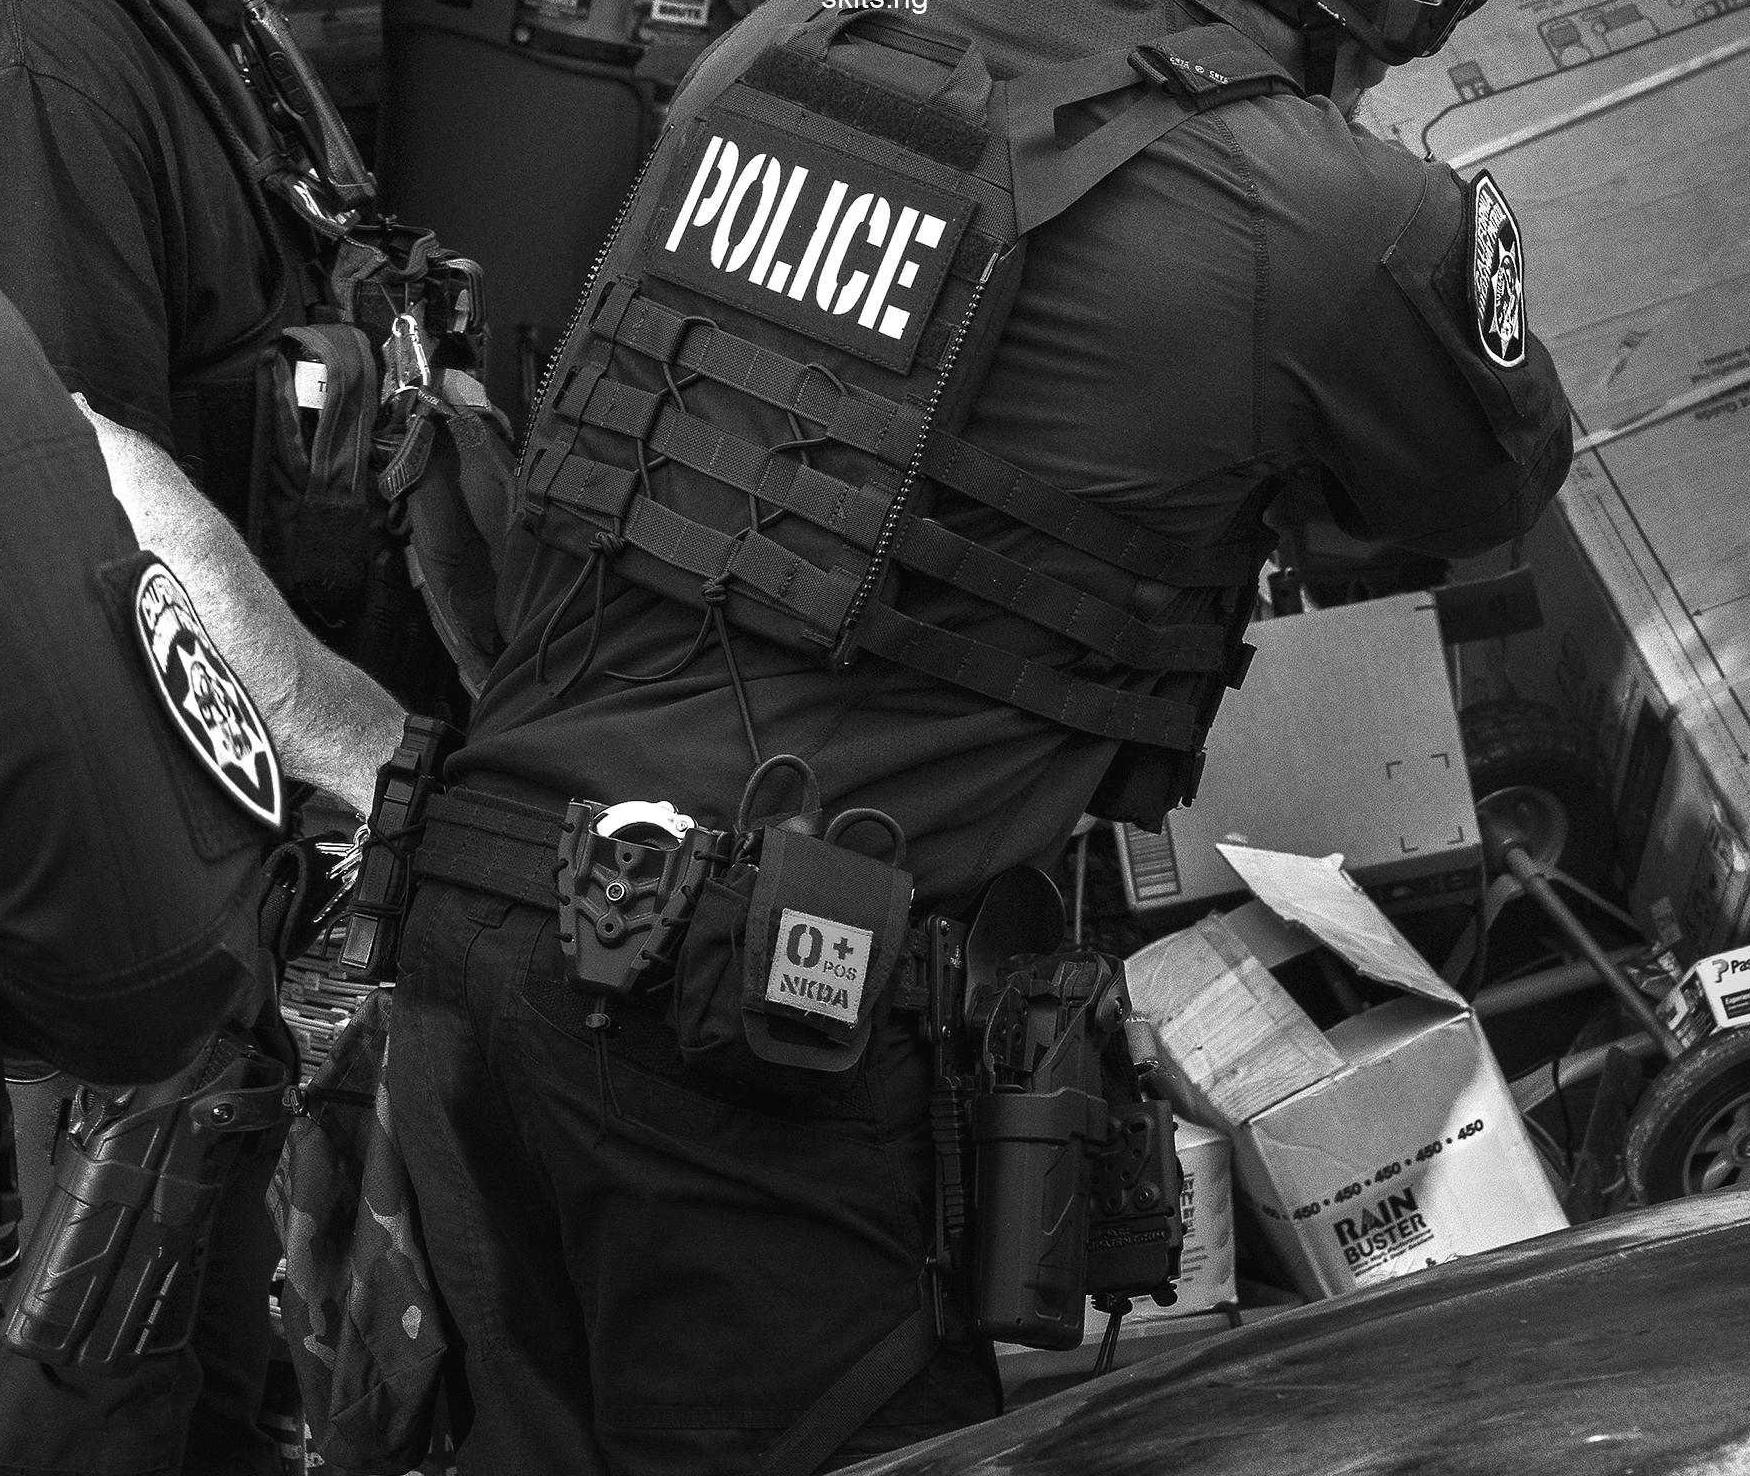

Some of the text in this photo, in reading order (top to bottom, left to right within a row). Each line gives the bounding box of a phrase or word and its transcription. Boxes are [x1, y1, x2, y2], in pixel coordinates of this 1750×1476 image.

[664, 135, 947, 340] POLICE
[780, 972, 850, 1009] NKDA
[822, 960, 857, 982] POS
[1293, 1201, 1319, 1219] 450
[1334, 1181, 1361, 1202] 450
[1374, 1160, 1401, 1182] 450
[1415, 1139, 1442, 1161] 450
[1457, 1119, 1484, 1140] 450
[1333, 1187, 1419, 1247] RAIN
[1344, 1212, 1427, 1265] BUSTER
